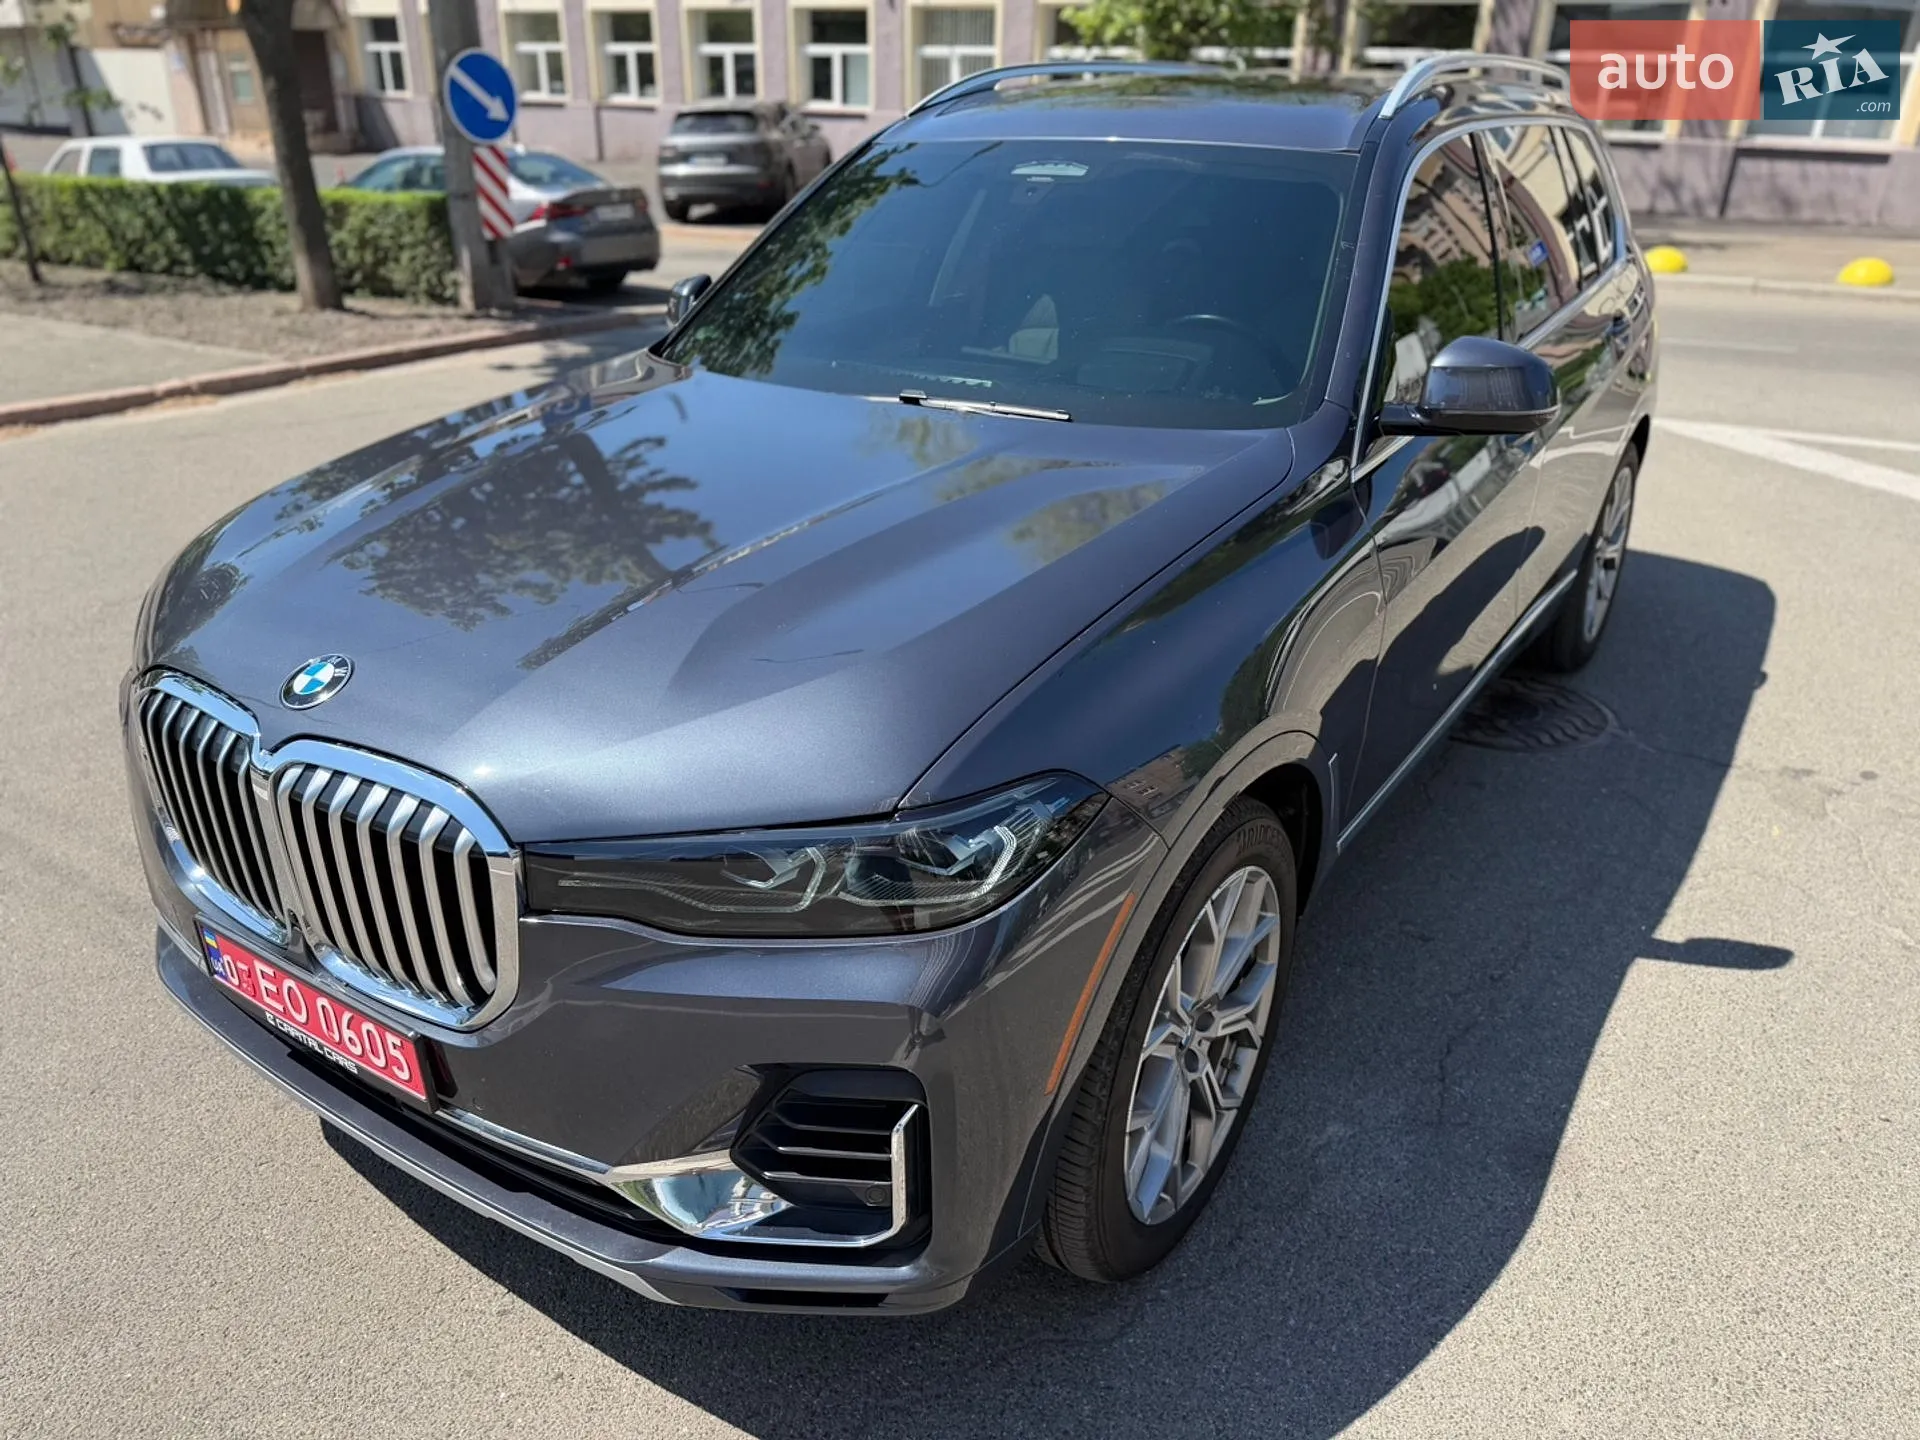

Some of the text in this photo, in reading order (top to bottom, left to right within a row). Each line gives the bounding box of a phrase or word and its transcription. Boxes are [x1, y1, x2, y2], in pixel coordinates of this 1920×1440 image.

[253, 959, 308, 1024] EO
[316, 997, 412, 1081] 0605
[277, 1018, 358, 1075] CAPITAL CARS
